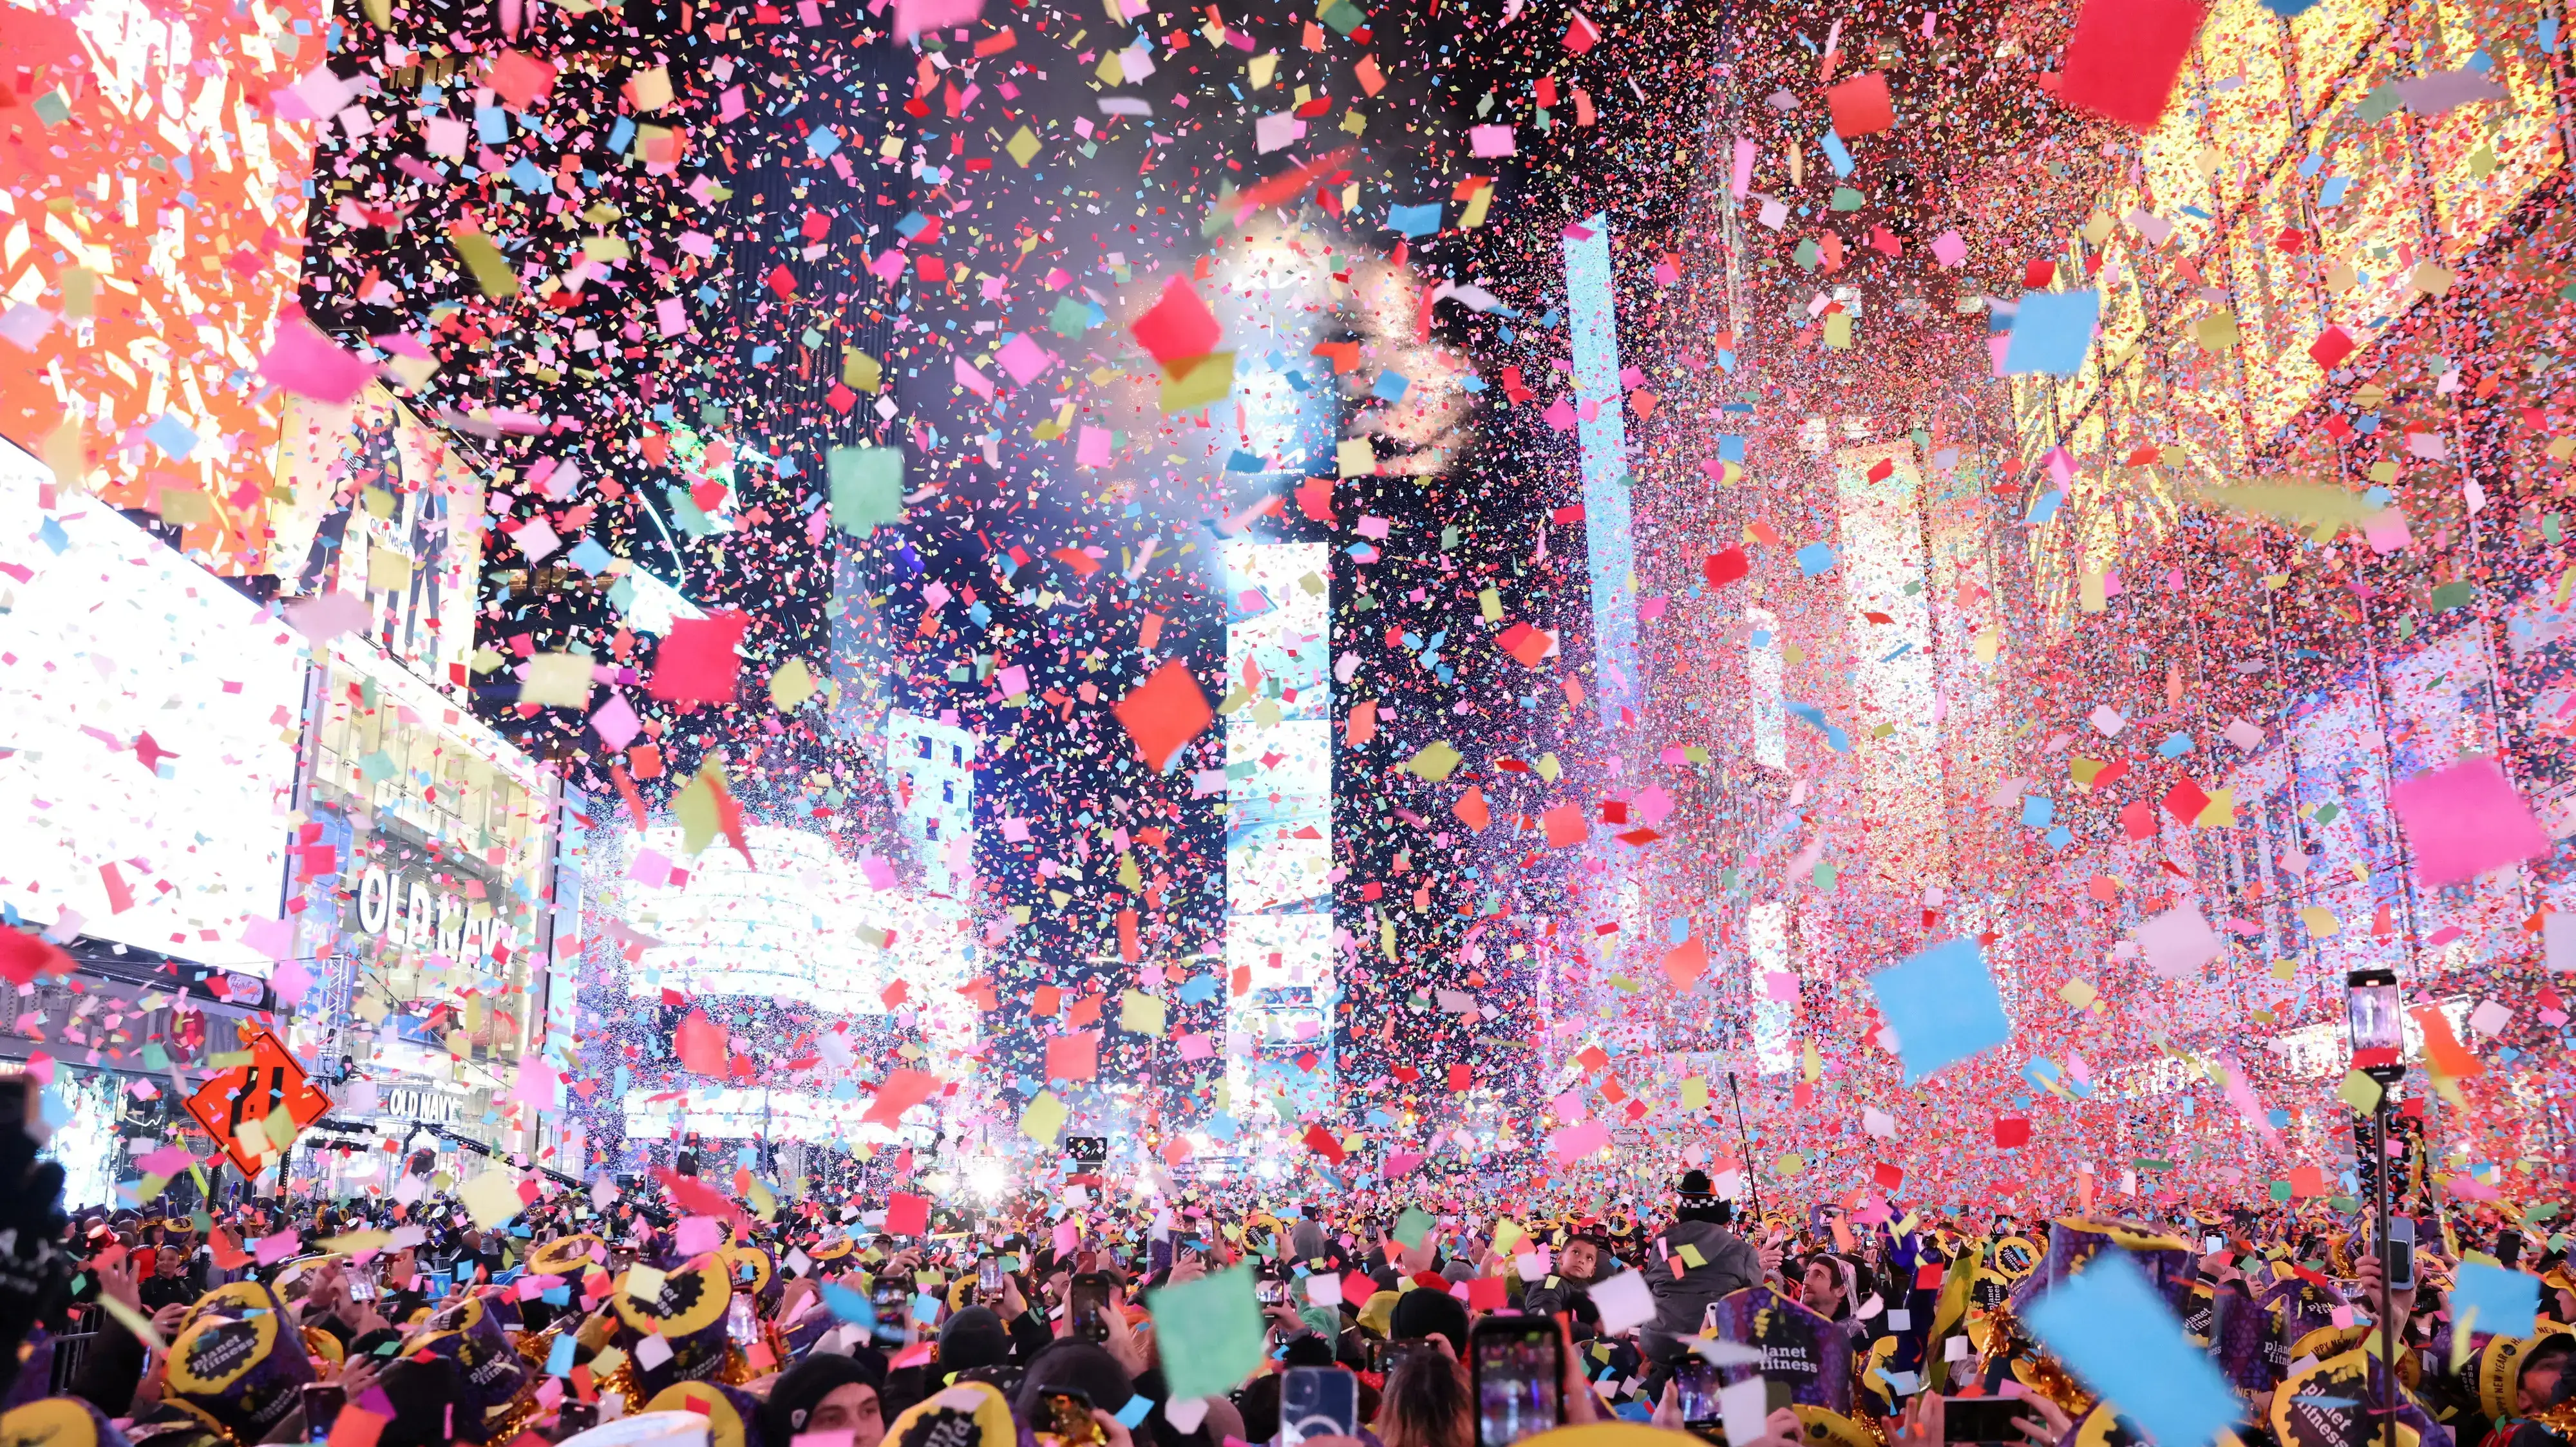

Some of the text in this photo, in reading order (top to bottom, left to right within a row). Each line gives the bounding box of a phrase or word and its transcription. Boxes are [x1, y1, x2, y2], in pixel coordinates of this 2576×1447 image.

[357, 865, 431, 951] OLD
[388, 1088, 457, 1122] OLD NAVY
[1250, 1226, 1263, 1240] plane
[2003, 1253, 2021, 1272] fitness
[2190, 1316, 2213, 1331] fitne
[192, 1334, 241, 1372] planet
[201, 1338, 255, 1373] fitness
[1761, 1344, 1807, 1359] lanet
[2263, 1340, 2291, 1354] plane
[469, 1350, 505, 1384] planet
[1759, 1357, 1818, 1373] fitness
